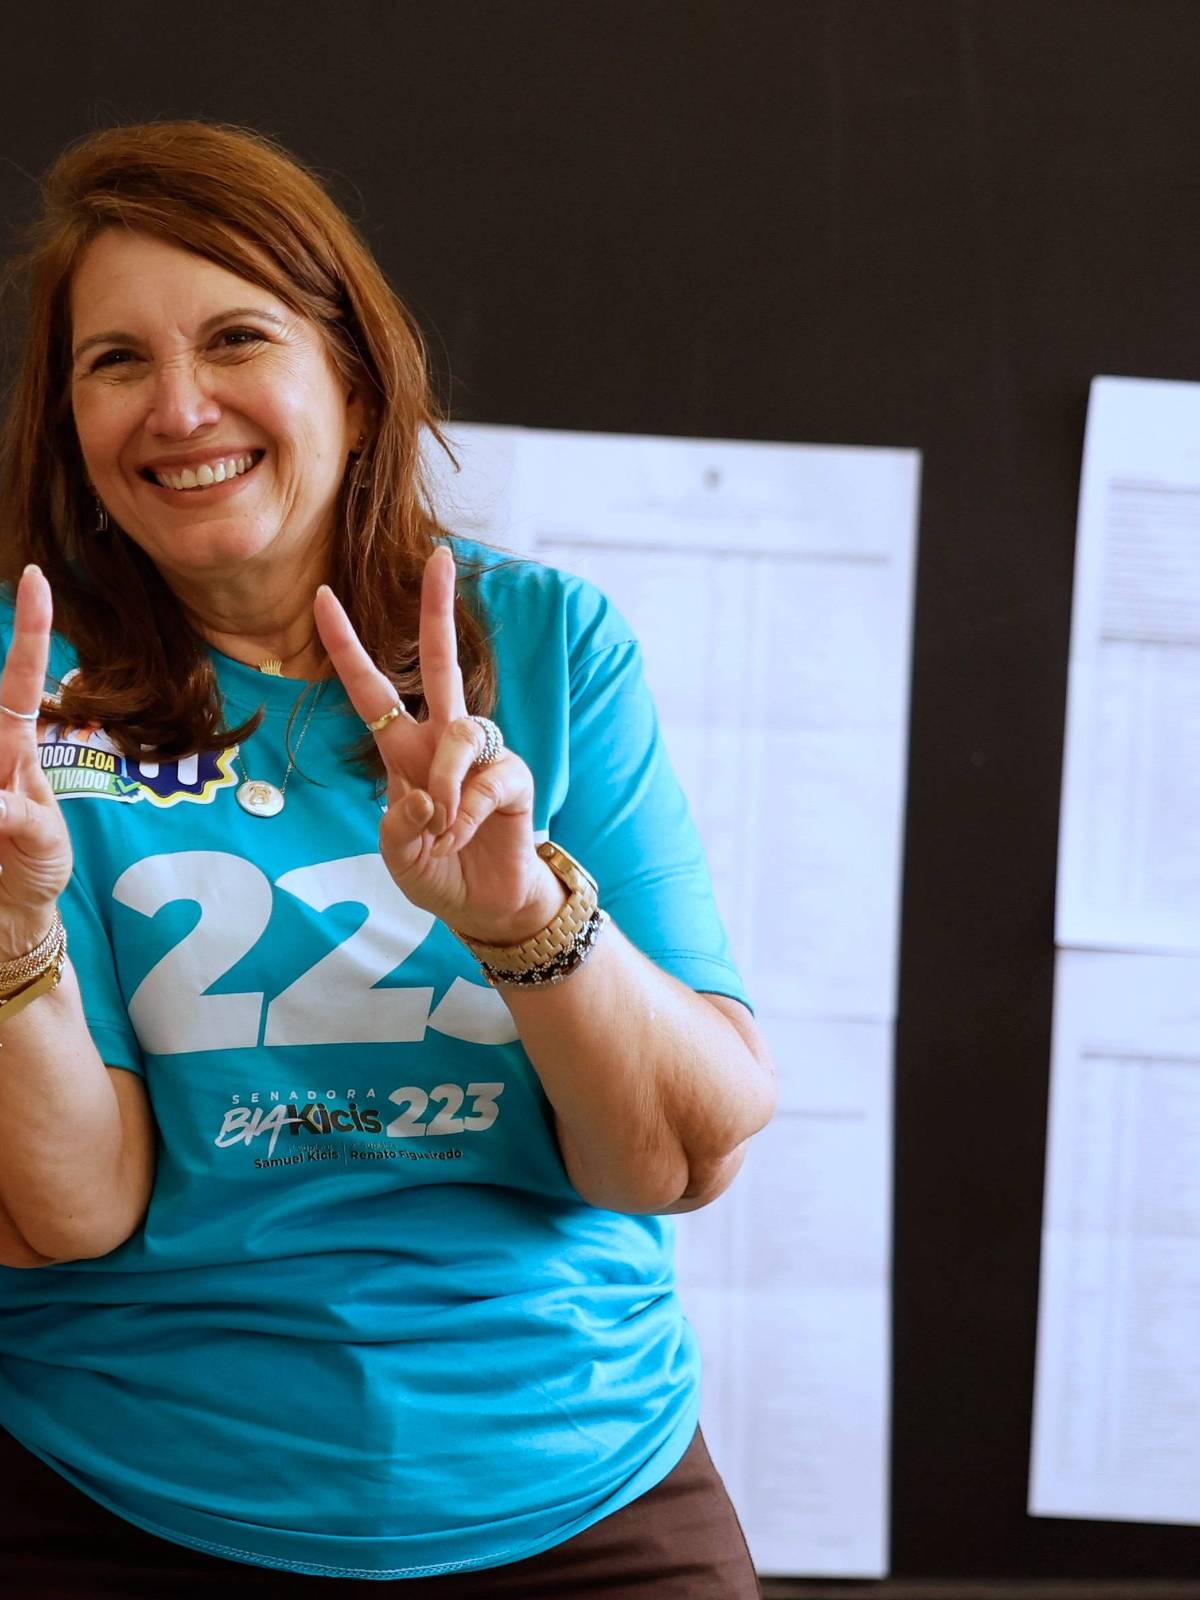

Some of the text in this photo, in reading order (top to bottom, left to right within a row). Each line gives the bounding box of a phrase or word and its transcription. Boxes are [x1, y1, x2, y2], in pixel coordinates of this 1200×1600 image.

[38, 745, 76, 769] ODO
[77, 747, 116, 773] LEOA
[231, 1088, 376, 1105] SENADORA
[386, 1082, 505, 1138] 223
[254, 1154, 304, 1169] Samuel
[307, 1148, 339, 1162] Kicis
[350, 1148, 397, 1161] Renato
[399, 1147, 463, 1162] Figueiredo
